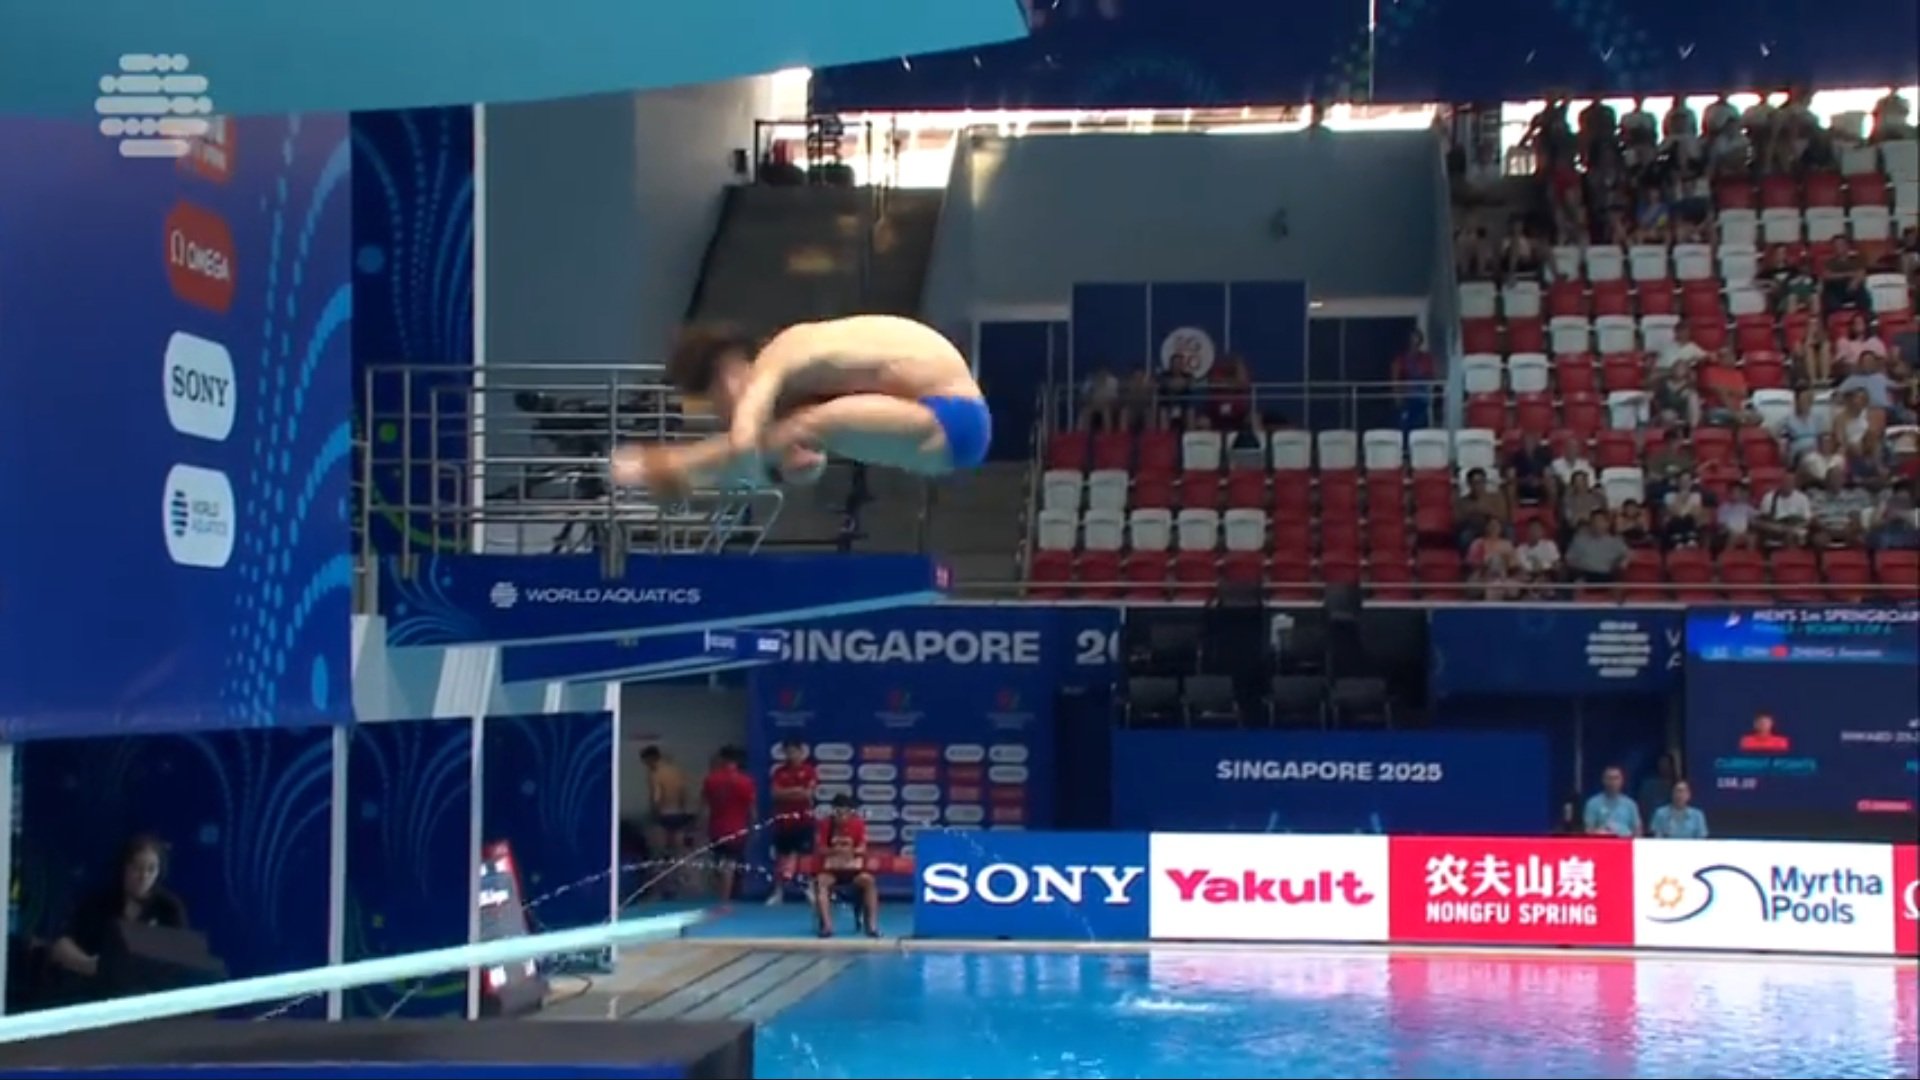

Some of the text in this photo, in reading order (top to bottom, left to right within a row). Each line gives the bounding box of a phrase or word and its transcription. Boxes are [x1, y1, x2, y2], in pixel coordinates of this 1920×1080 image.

[186, 242, 230, 281] OMEGA
[172, 364, 229, 408] SONY
[525, 587, 701, 604] WORLD AQUATICS
[1216, 760, 1443, 782] SINGAPORE 2025
[922, 862, 1145, 904] SONY
[1165, 869, 1375, 907] Yakult
[1424, 854, 1597, 900] 农夫山泉
[1770, 865, 1883, 898] Myrtha
[1426, 900, 1598, 926] NONGFU SPRING
[1770, 896, 1855, 924] Pools
